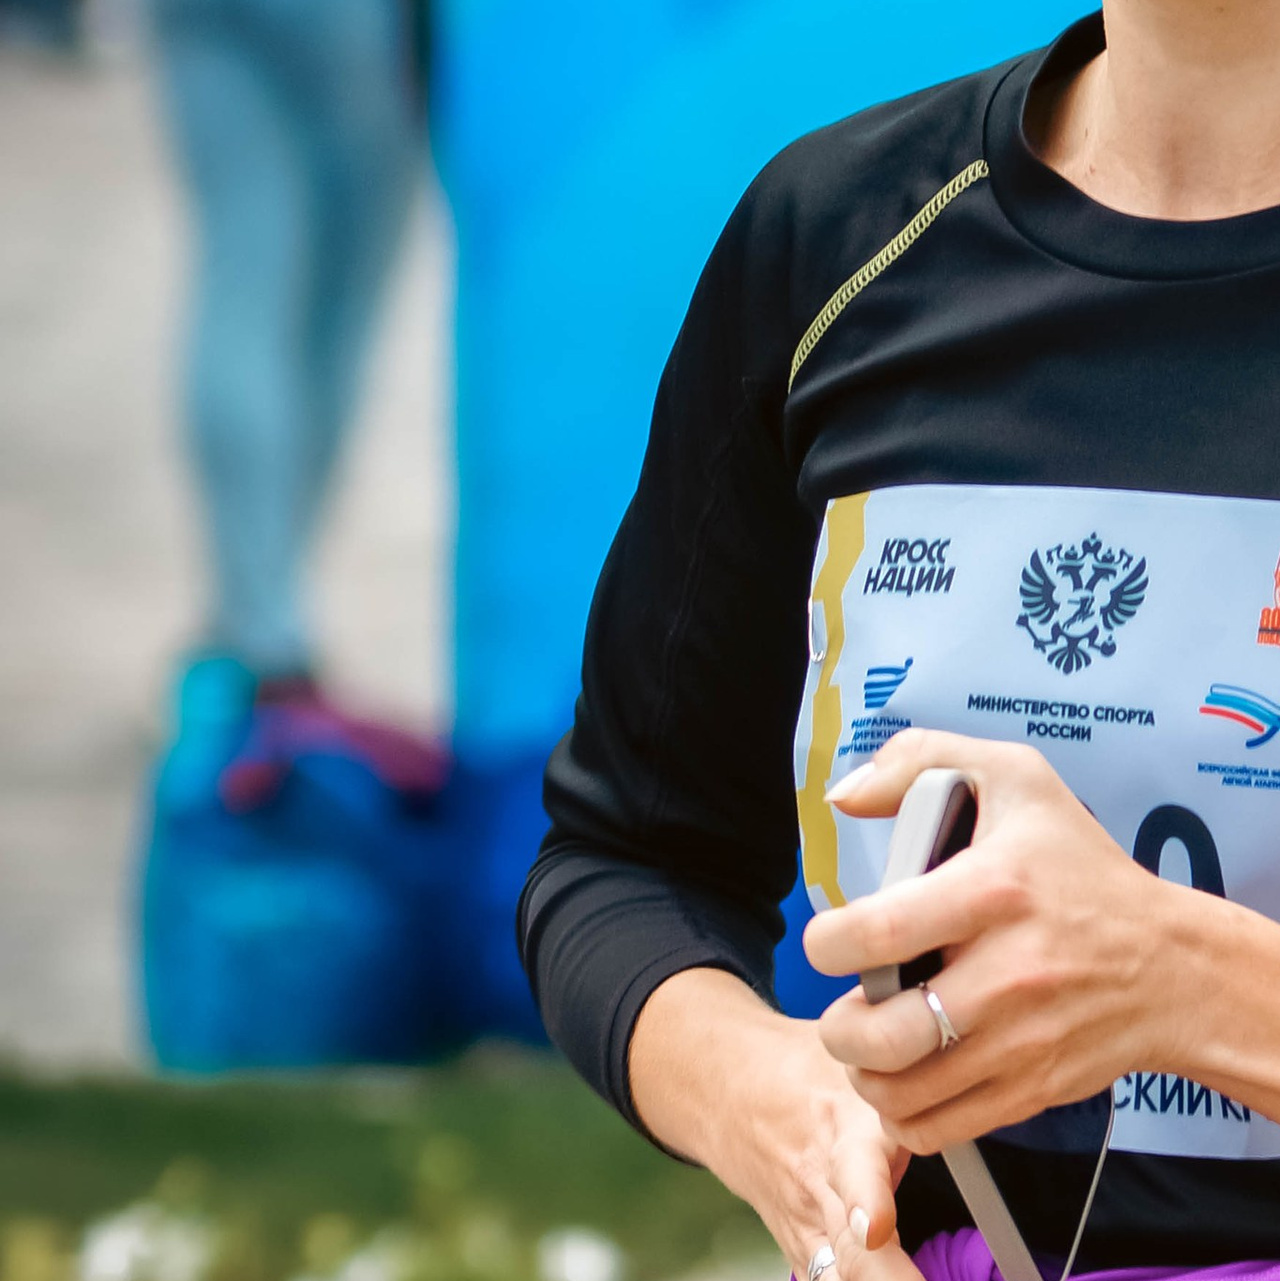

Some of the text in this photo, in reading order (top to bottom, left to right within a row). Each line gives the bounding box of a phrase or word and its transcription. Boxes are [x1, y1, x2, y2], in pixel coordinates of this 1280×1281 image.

[880, 538, 951, 565] КРОСС
[863, 566, 956, 596] НАЦИИ
[967, 694, 1156, 726] МИНИСТЕРСТВО СПОРТА
[1027, 722, 1092, 742] РОССИИ
